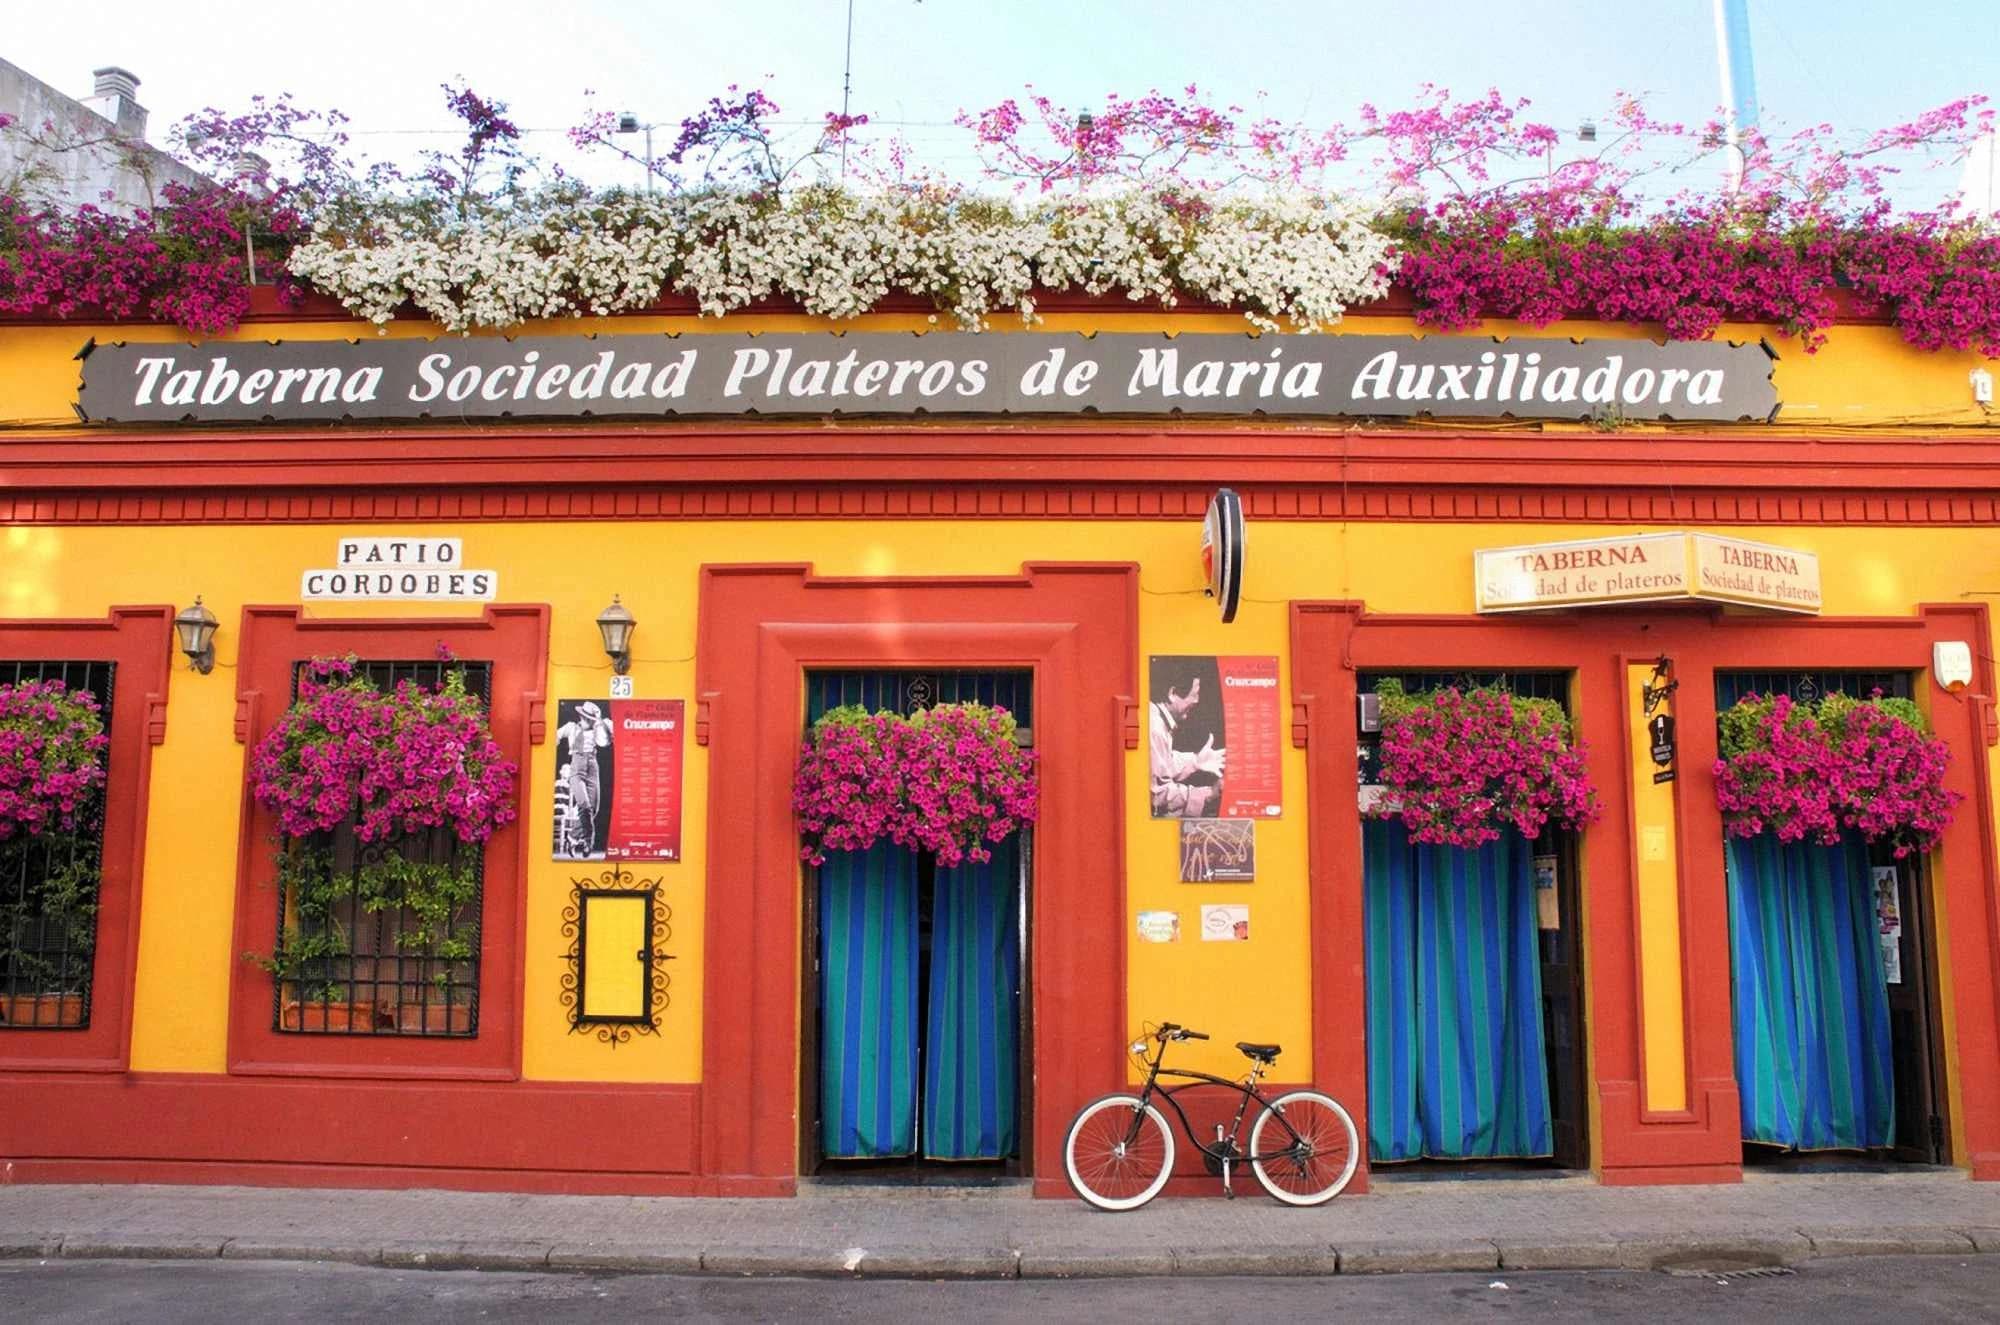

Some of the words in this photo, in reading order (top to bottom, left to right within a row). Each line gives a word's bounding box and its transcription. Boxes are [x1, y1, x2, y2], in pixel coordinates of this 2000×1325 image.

[134, 356, 384, 406] Taberna
[408, 348, 698, 402] Sociedad
[723, 347, 989, 398] Plateros
[1019, 347, 1099, 398] de
[1127, 347, 1323, 399] María
[1350, 350, 1726, 406] Auxiliadora
[342, 543, 454, 563] PATIO
[1516, 545, 1648, 574] TABERNA
[1720, 545, 1800, 576] TABERNA
[307, 573, 489, 595] CORDOBES
[1575, 575, 1598, 594] de
[1606, 571, 1683, 595] plateros
[1702, 566, 1755, 593] Sociedad
[1757, 576, 1772, 596] de
[1775, 580, 1819, 601] plateros
[612, 676, 631, 696] 25
